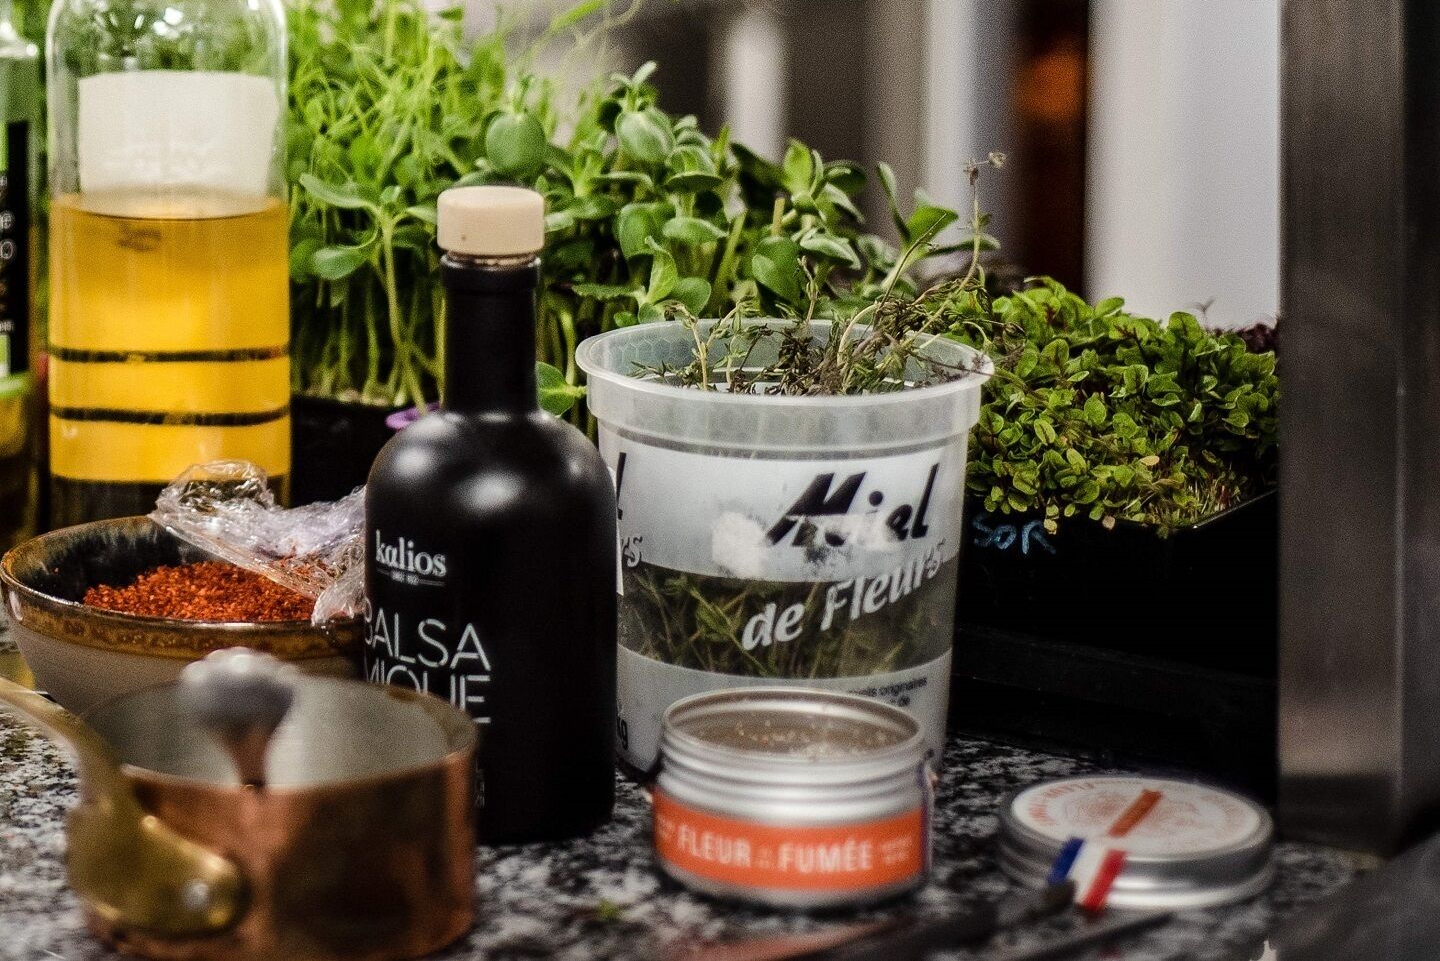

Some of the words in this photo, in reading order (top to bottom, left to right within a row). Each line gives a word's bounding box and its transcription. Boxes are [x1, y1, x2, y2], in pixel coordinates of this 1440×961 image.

[375, 528, 447, 577] kalios
[741, 602, 805, 651] de
[820, 538, 946, 631] Fleurs
[677, 823, 751, 868] FLEUR
[777, 838, 873, 873] FUMÉE
